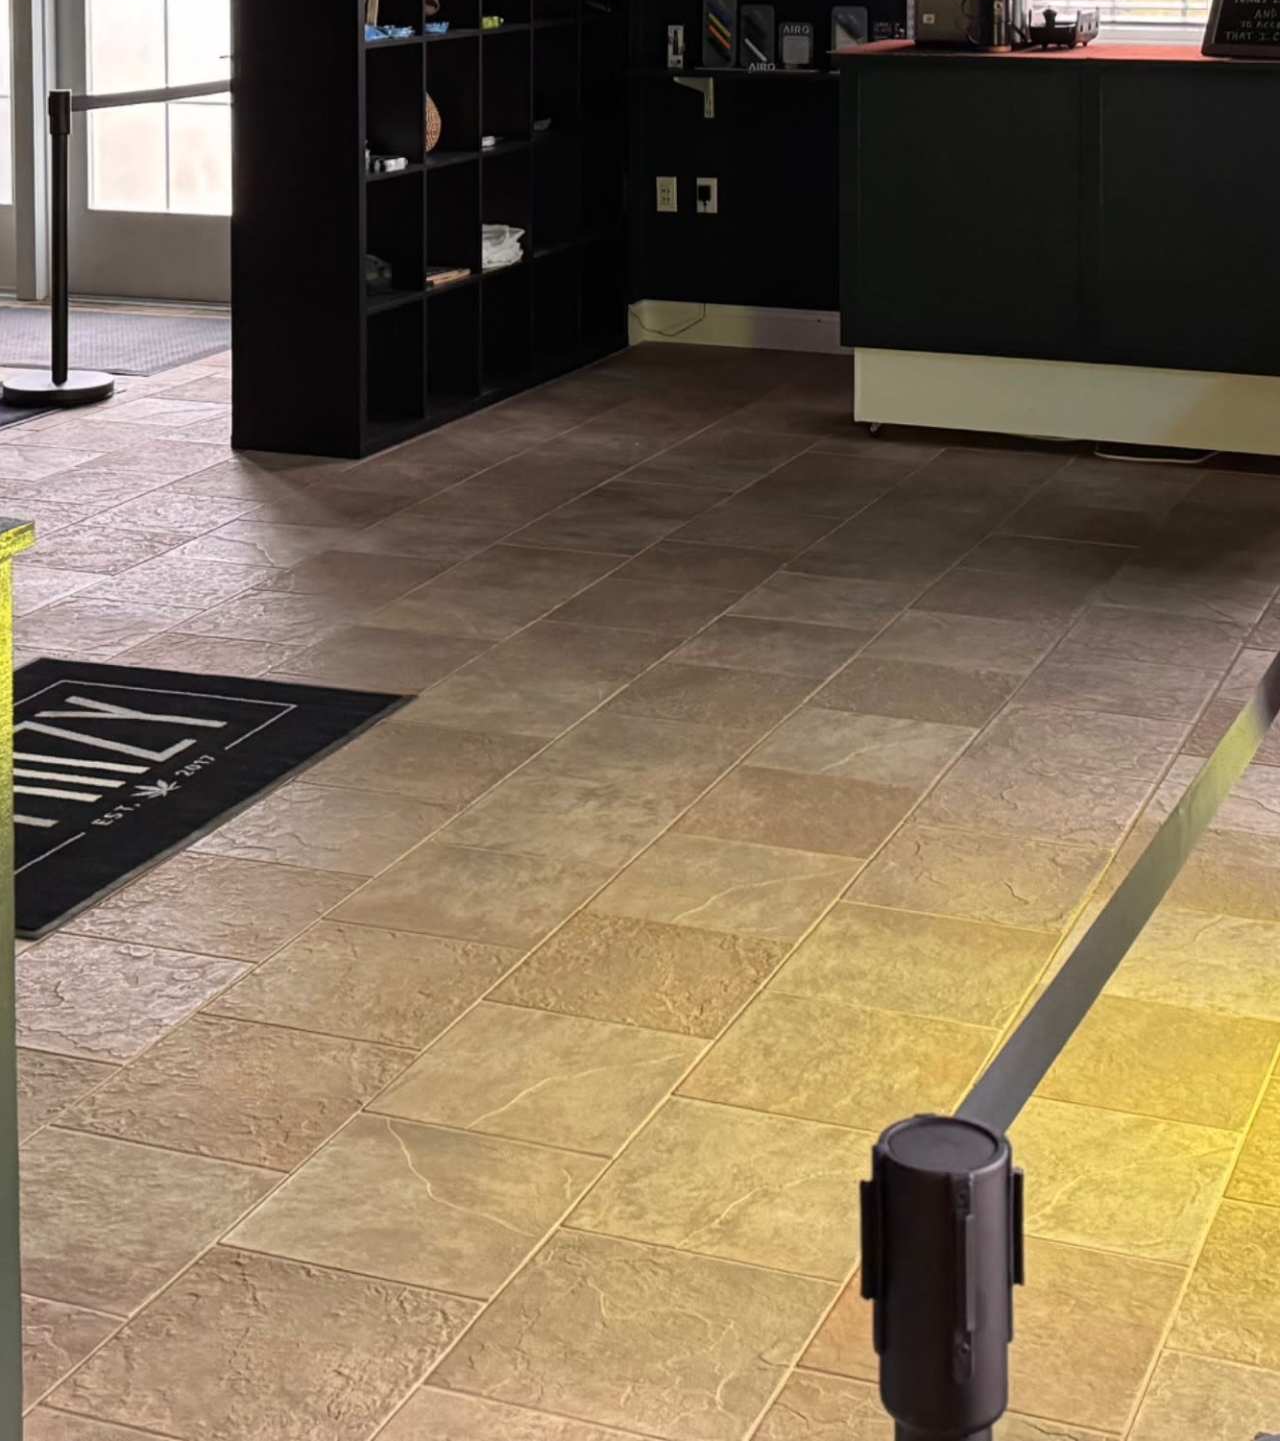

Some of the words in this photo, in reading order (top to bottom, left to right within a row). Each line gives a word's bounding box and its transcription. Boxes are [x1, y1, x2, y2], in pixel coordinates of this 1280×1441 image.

[783, 24, 810, 34] AIRO
[91, 803, 141, 826] EST.
[174, 754, 217, 777] 2017
